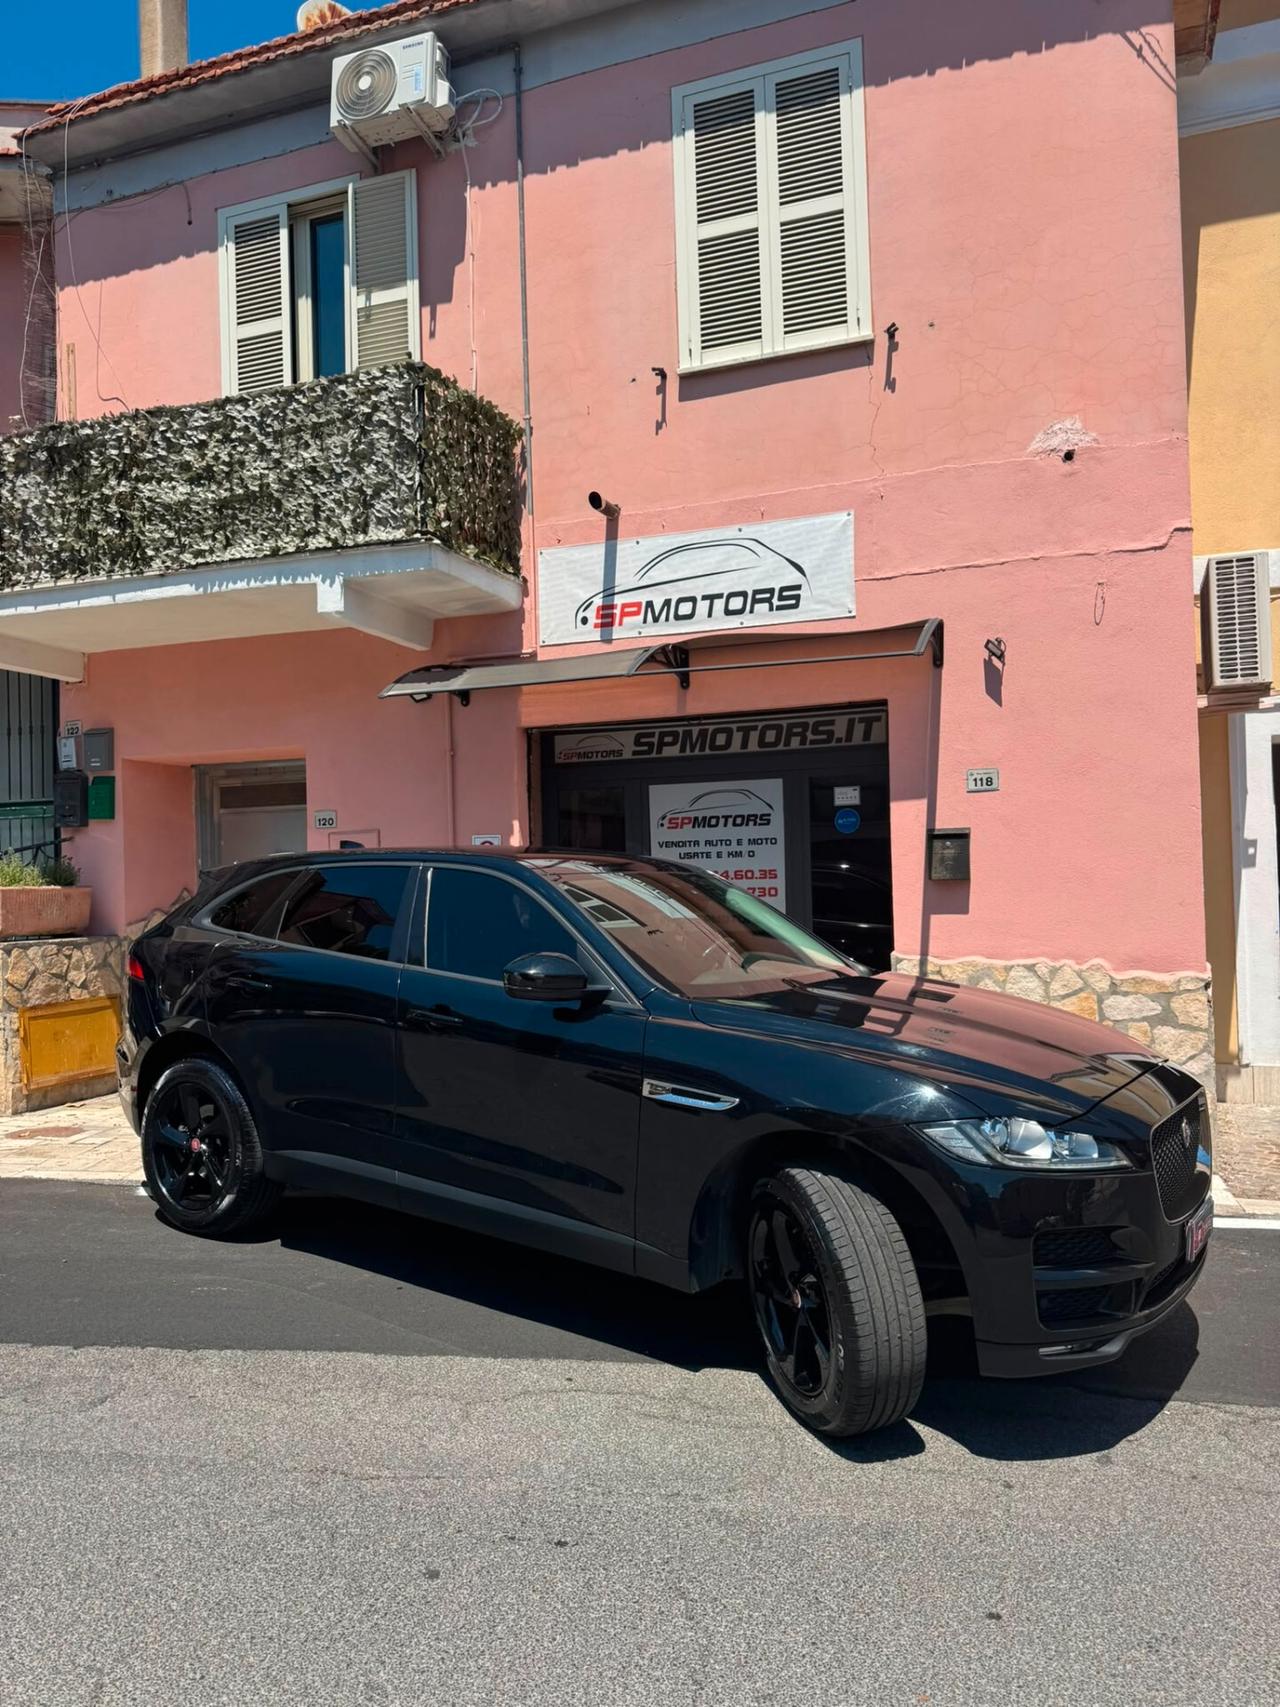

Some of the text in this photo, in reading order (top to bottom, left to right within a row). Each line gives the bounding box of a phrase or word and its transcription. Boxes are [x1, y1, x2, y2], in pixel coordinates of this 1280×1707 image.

[593, 584, 802, 629] SPMOTORS
[631, 715, 881, 756] SPMOTORS.IT
[973, 776, 993, 787] 118
[317, 817, 334, 827] 120
[666, 813, 771, 829] SPMOTORS
[657, 837, 778, 849] VENDITA AUTO E MOTO
[678, 851, 712, 860] USATE
[716, 850, 723, 859] E
